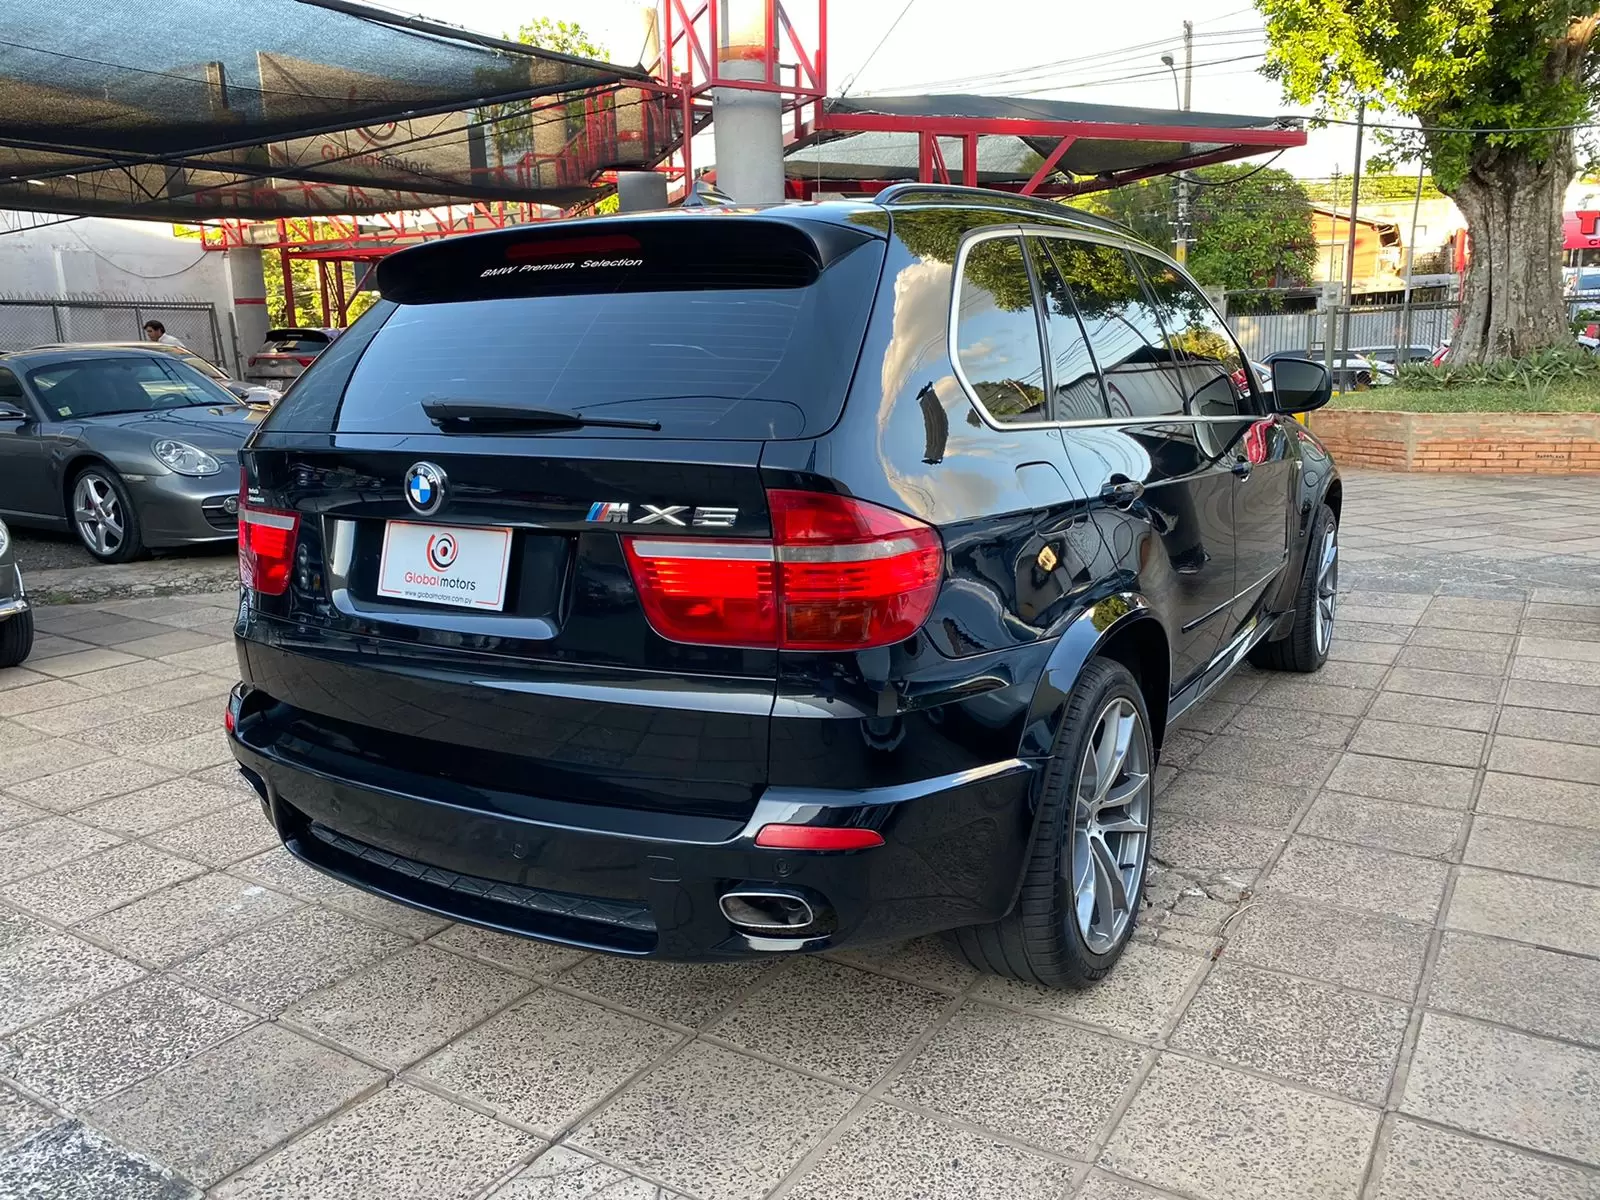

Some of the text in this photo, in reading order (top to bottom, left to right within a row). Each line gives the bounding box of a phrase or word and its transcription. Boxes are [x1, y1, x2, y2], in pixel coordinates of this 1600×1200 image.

[480, 257, 643, 278] BMW Premium Selection
[408, 467, 438, 485] BMW
[632, 504, 739, 527] X5
[404, 571, 476, 591] Globalmotors
[404, 590, 472, 605] www.globalmotors.com.py
